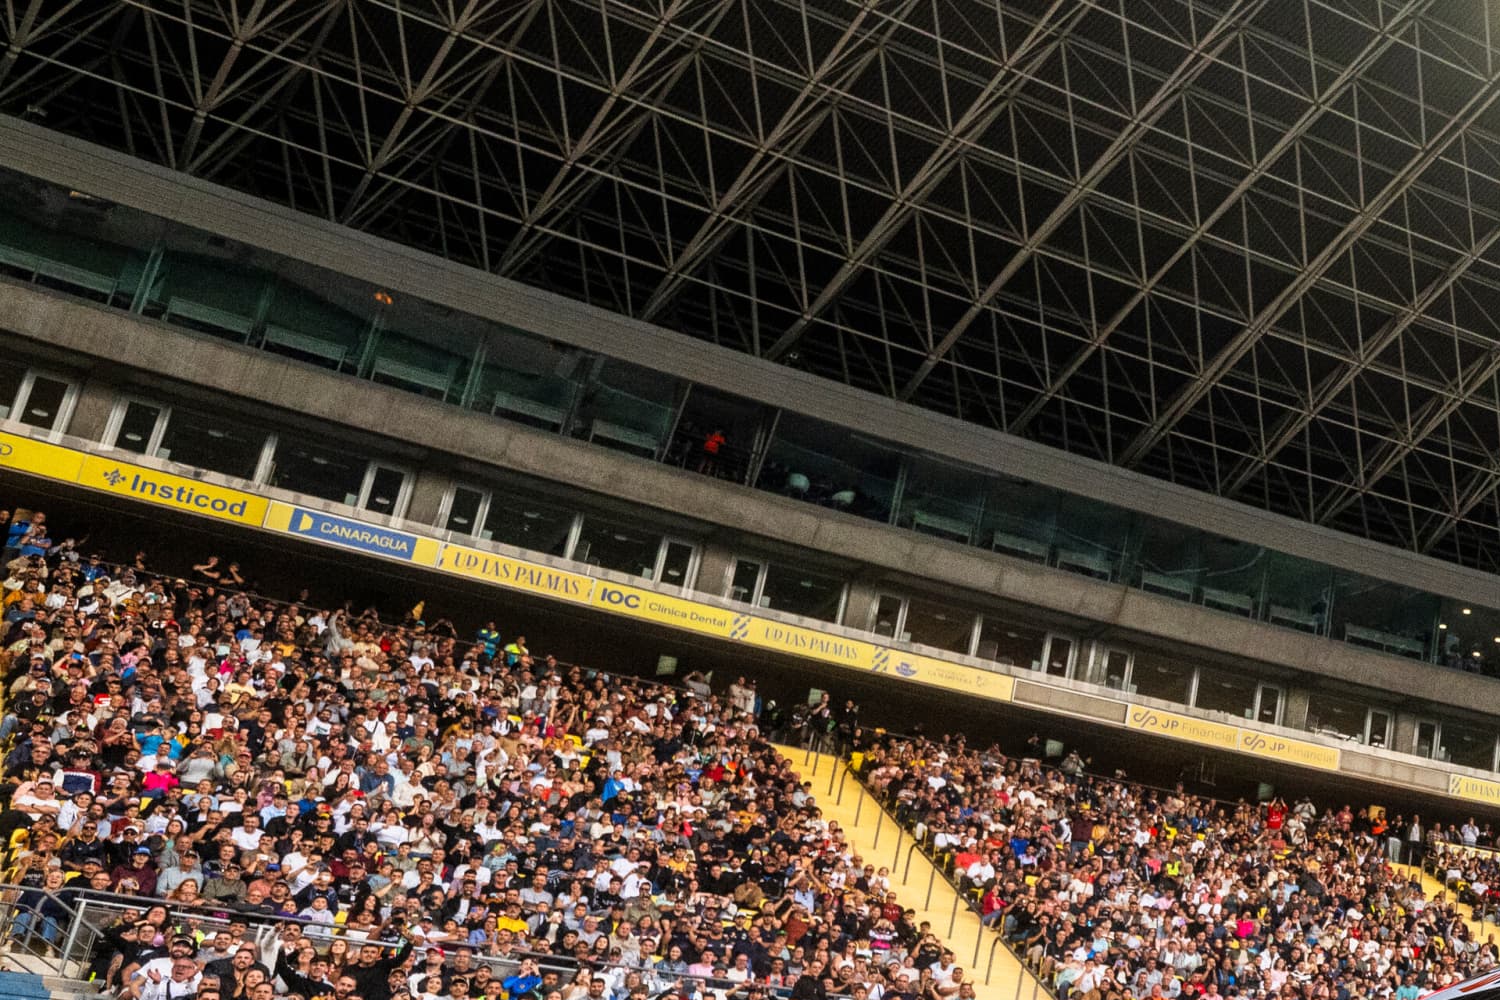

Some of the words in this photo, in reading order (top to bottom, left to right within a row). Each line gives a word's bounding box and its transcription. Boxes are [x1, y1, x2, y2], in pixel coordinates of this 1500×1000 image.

[131, 474, 248, 517] Insticod
[320, 521, 408, 553] CANARAGUA
[454, 551, 478, 570] UD
[482, 557, 510, 578] LAS
[515, 567, 580, 595] PALMAS
[601, 587, 641, 609] IOC
[690, 610, 727, 628] Dental
[765, 627, 783, 642] UD
[786, 631, 807, 649] LAS
[810, 637, 858, 660] PALMAS
[1161, 719, 1179, 730] JP
[1182, 722, 1236, 744] Financial
[1269, 742, 1285, 753] JP
[1287, 745, 1336, 764] Financial
[1480, 784, 1495, 799] LAS
